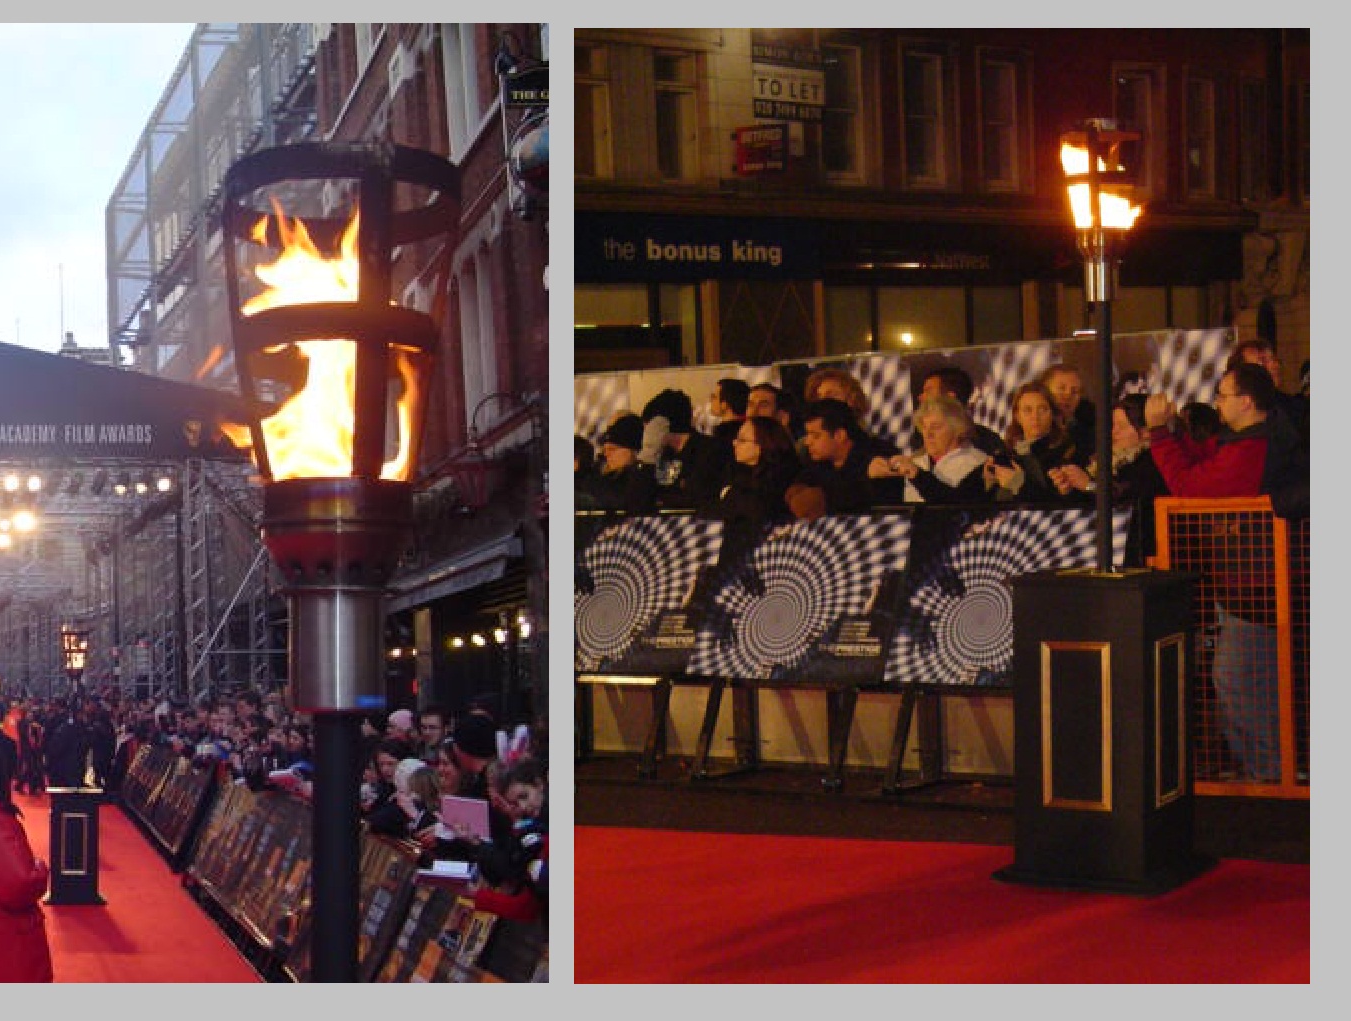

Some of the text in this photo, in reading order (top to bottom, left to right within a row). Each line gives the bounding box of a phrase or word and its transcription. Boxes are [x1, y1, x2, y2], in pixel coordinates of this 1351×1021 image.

[757, 77, 819, 100] TO LET
[603, 238, 783, 267] the bonus king
[64, 424, 97, 444] FILM
[99, 424, 152, 444] AWARDS
